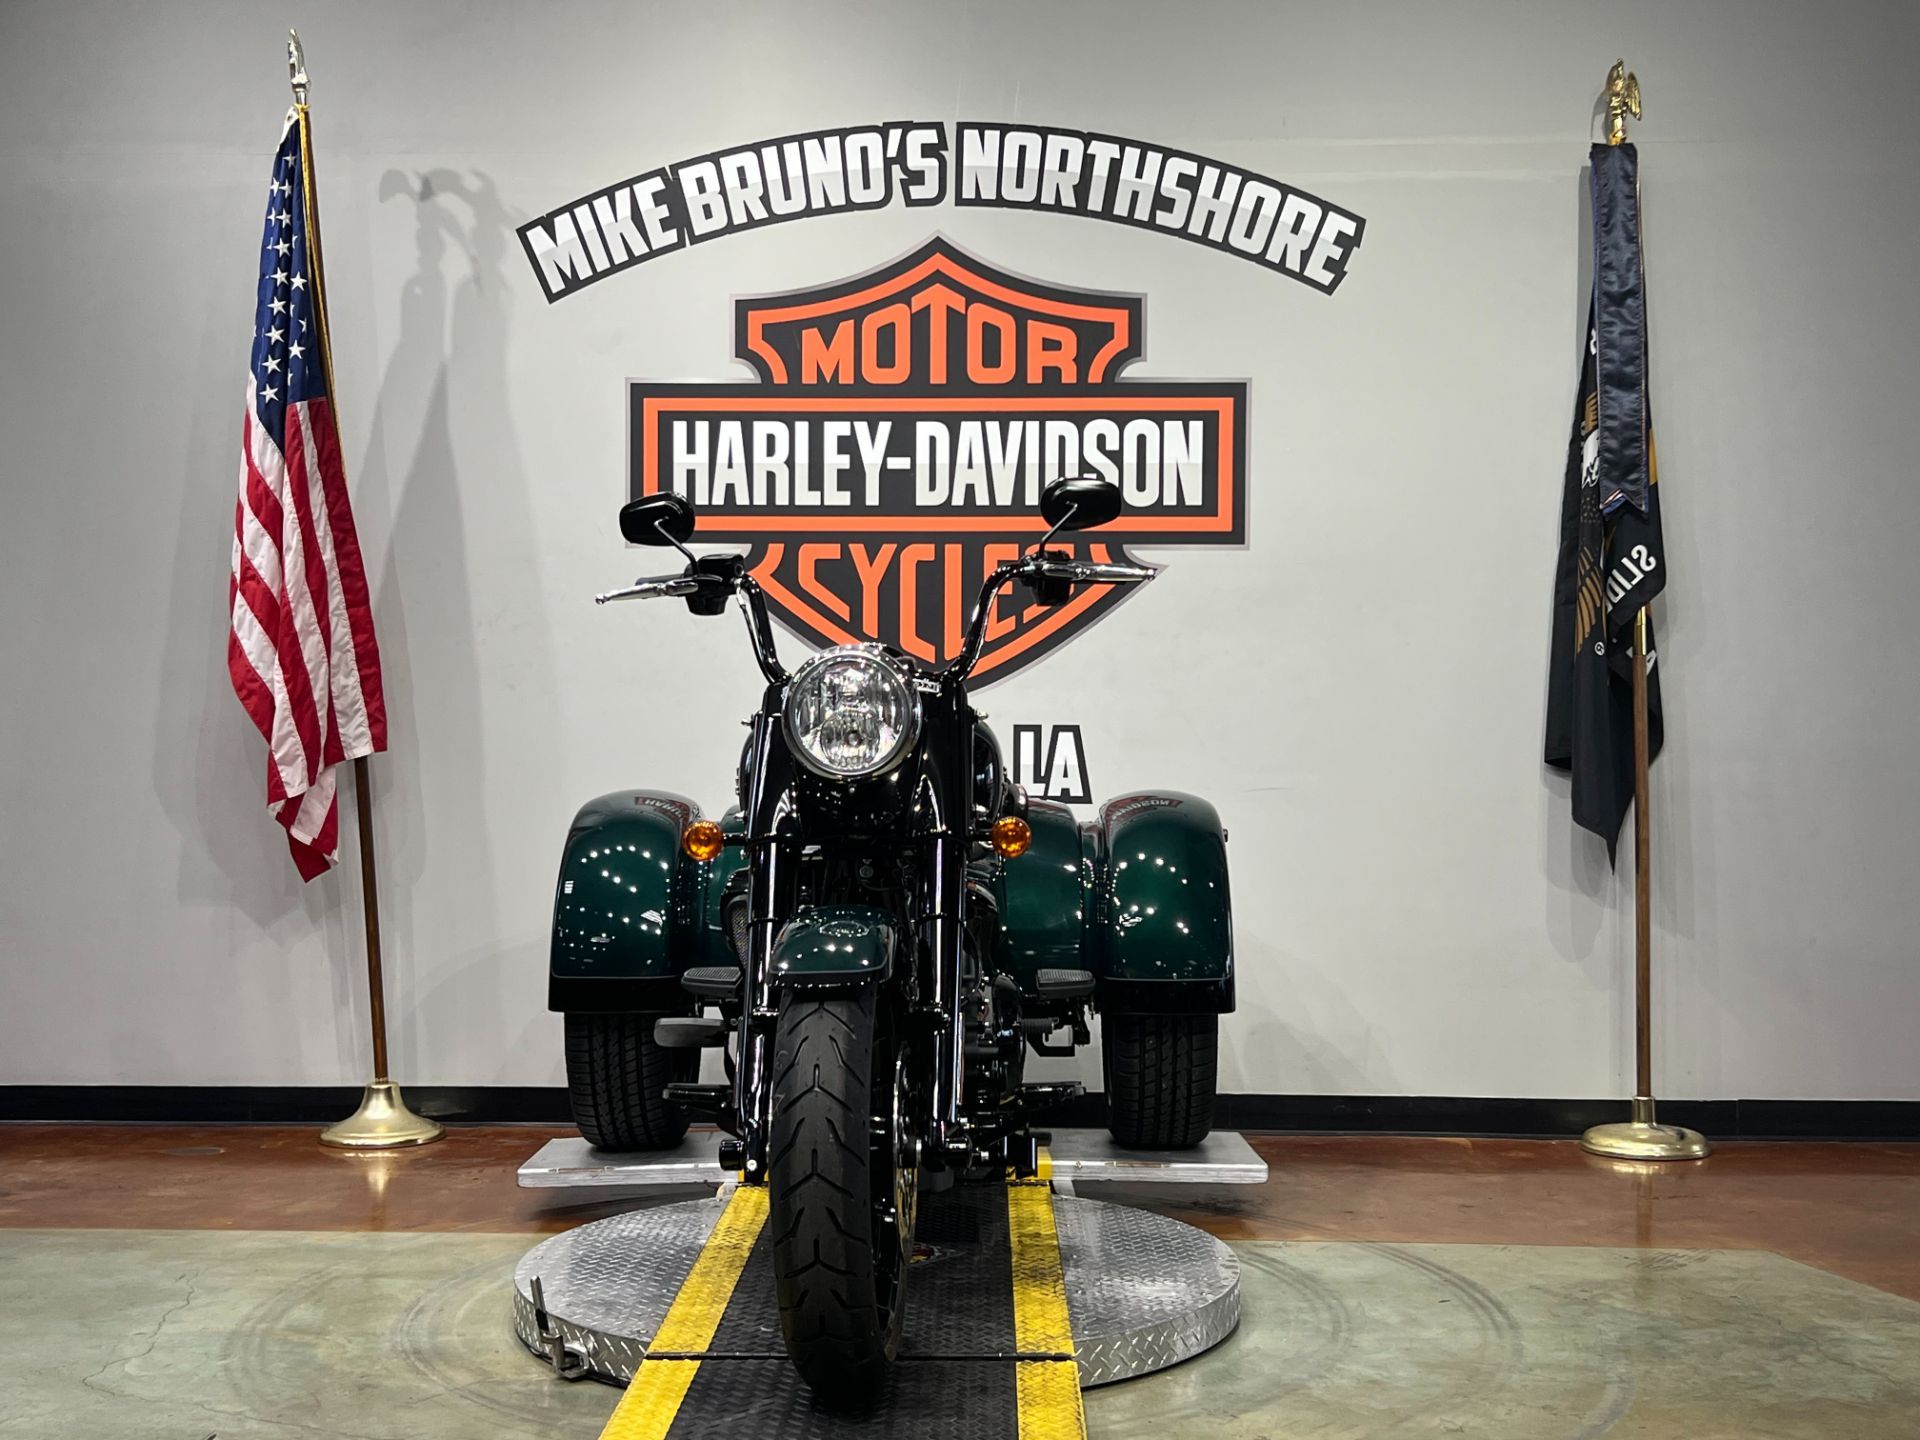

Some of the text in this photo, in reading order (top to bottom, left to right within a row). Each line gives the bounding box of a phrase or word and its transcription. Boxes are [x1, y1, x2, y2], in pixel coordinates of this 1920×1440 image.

[524, 127, 1358, 296] MIKE BRUNO'S NORTHSHORE
[802, 283, 1077, 384] MOTOR
[672, 418, 1204, 507] HARLEY-DAVIDSON
[1018, 729, 1087, 799] LA
